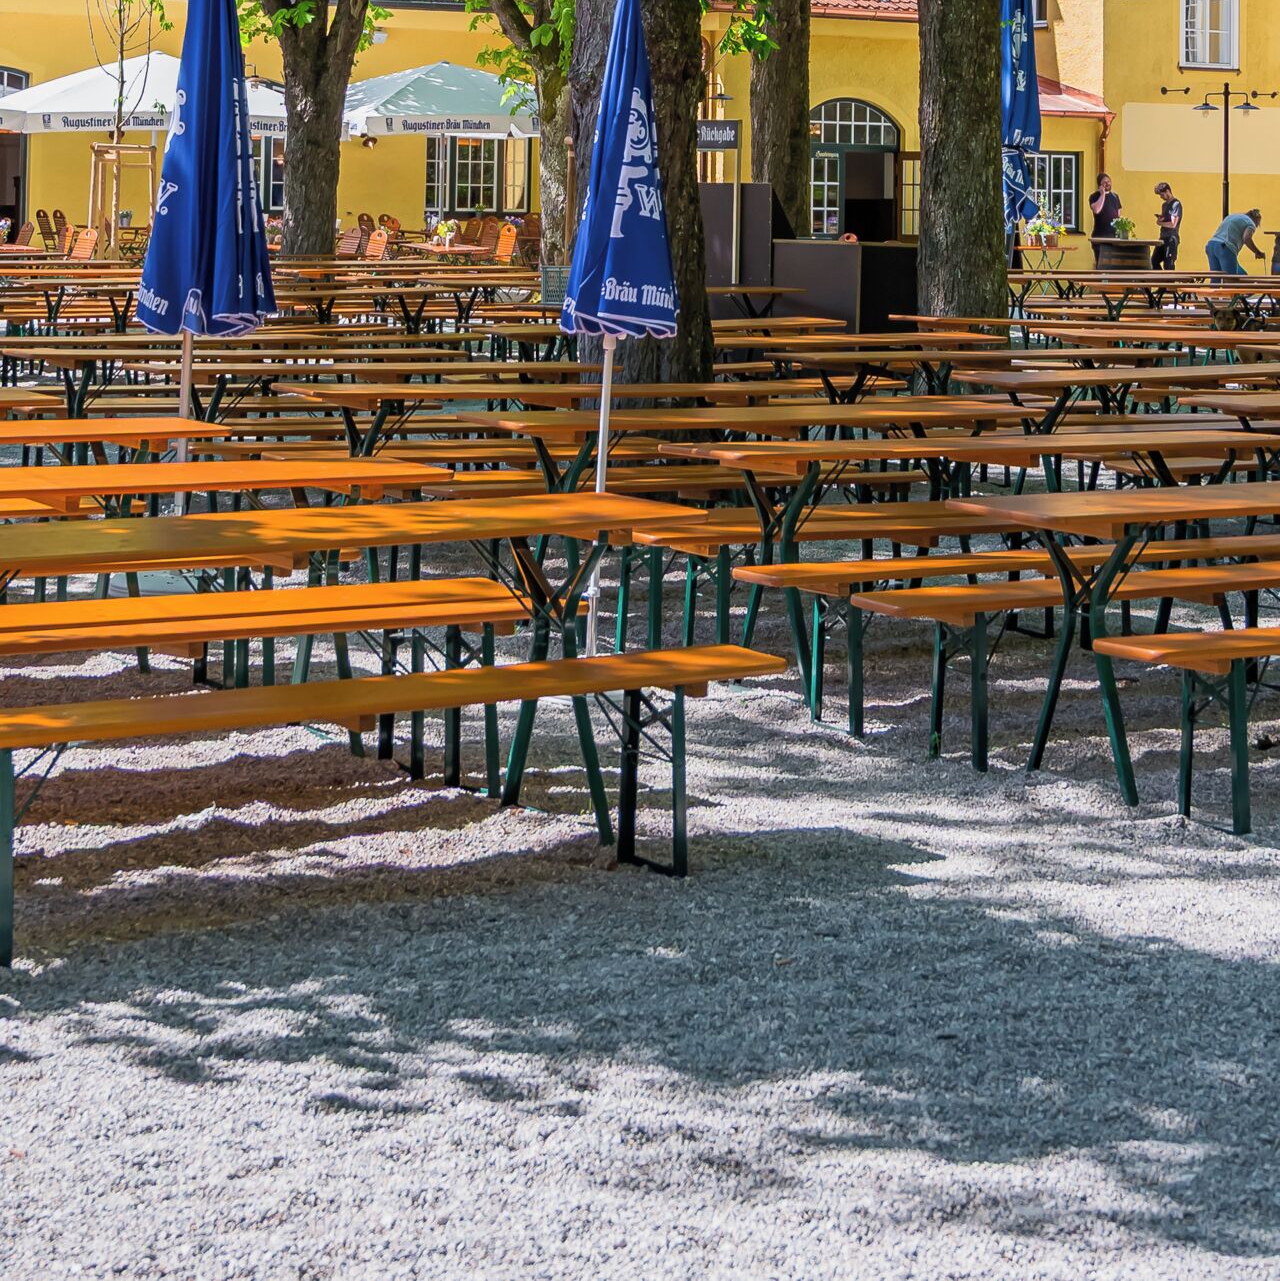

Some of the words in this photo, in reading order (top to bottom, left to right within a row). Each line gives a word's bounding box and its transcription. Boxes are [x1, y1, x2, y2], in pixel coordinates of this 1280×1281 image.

[132, 115, 164, 127] München
[462, 119, 491, 130] München
[700, 125, 736, 144] Rückgabe
